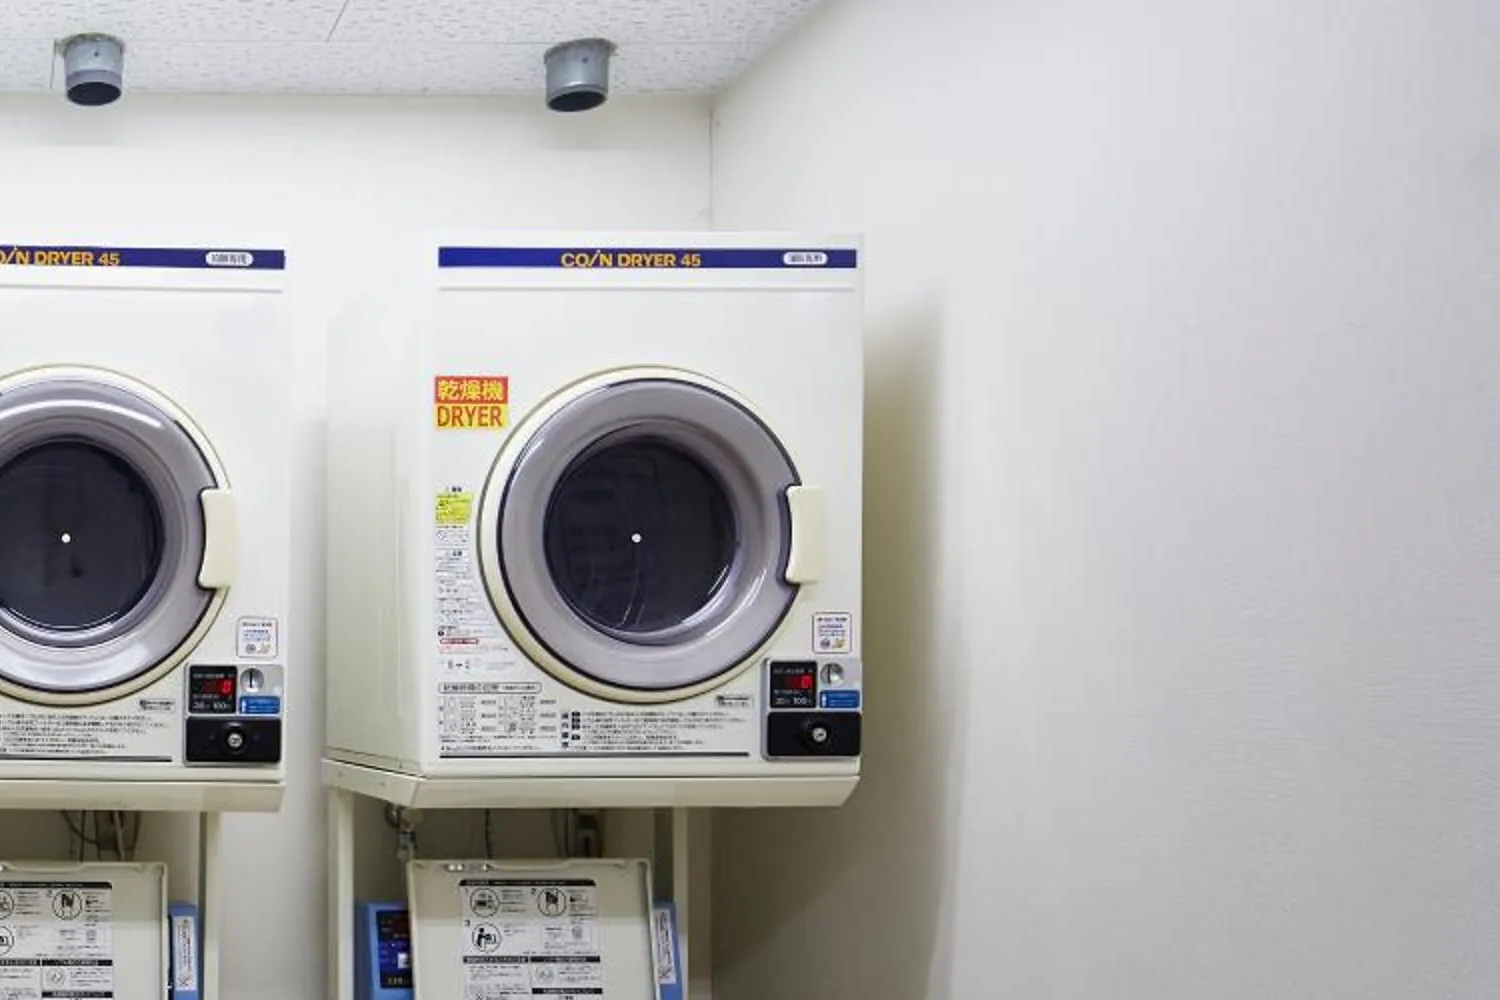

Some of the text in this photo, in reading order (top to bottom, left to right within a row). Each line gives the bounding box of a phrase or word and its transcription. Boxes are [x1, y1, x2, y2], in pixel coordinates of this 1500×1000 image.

[34, 251, 94, 266] DRYER
[98, 252, 121, 266] 45
[617, 253, 676, 267] DRYER
[681, 253, 701, 267] 45
[438, 379, 505, 401] 乾燥機
[437, 405, 502, 427] DRYER
